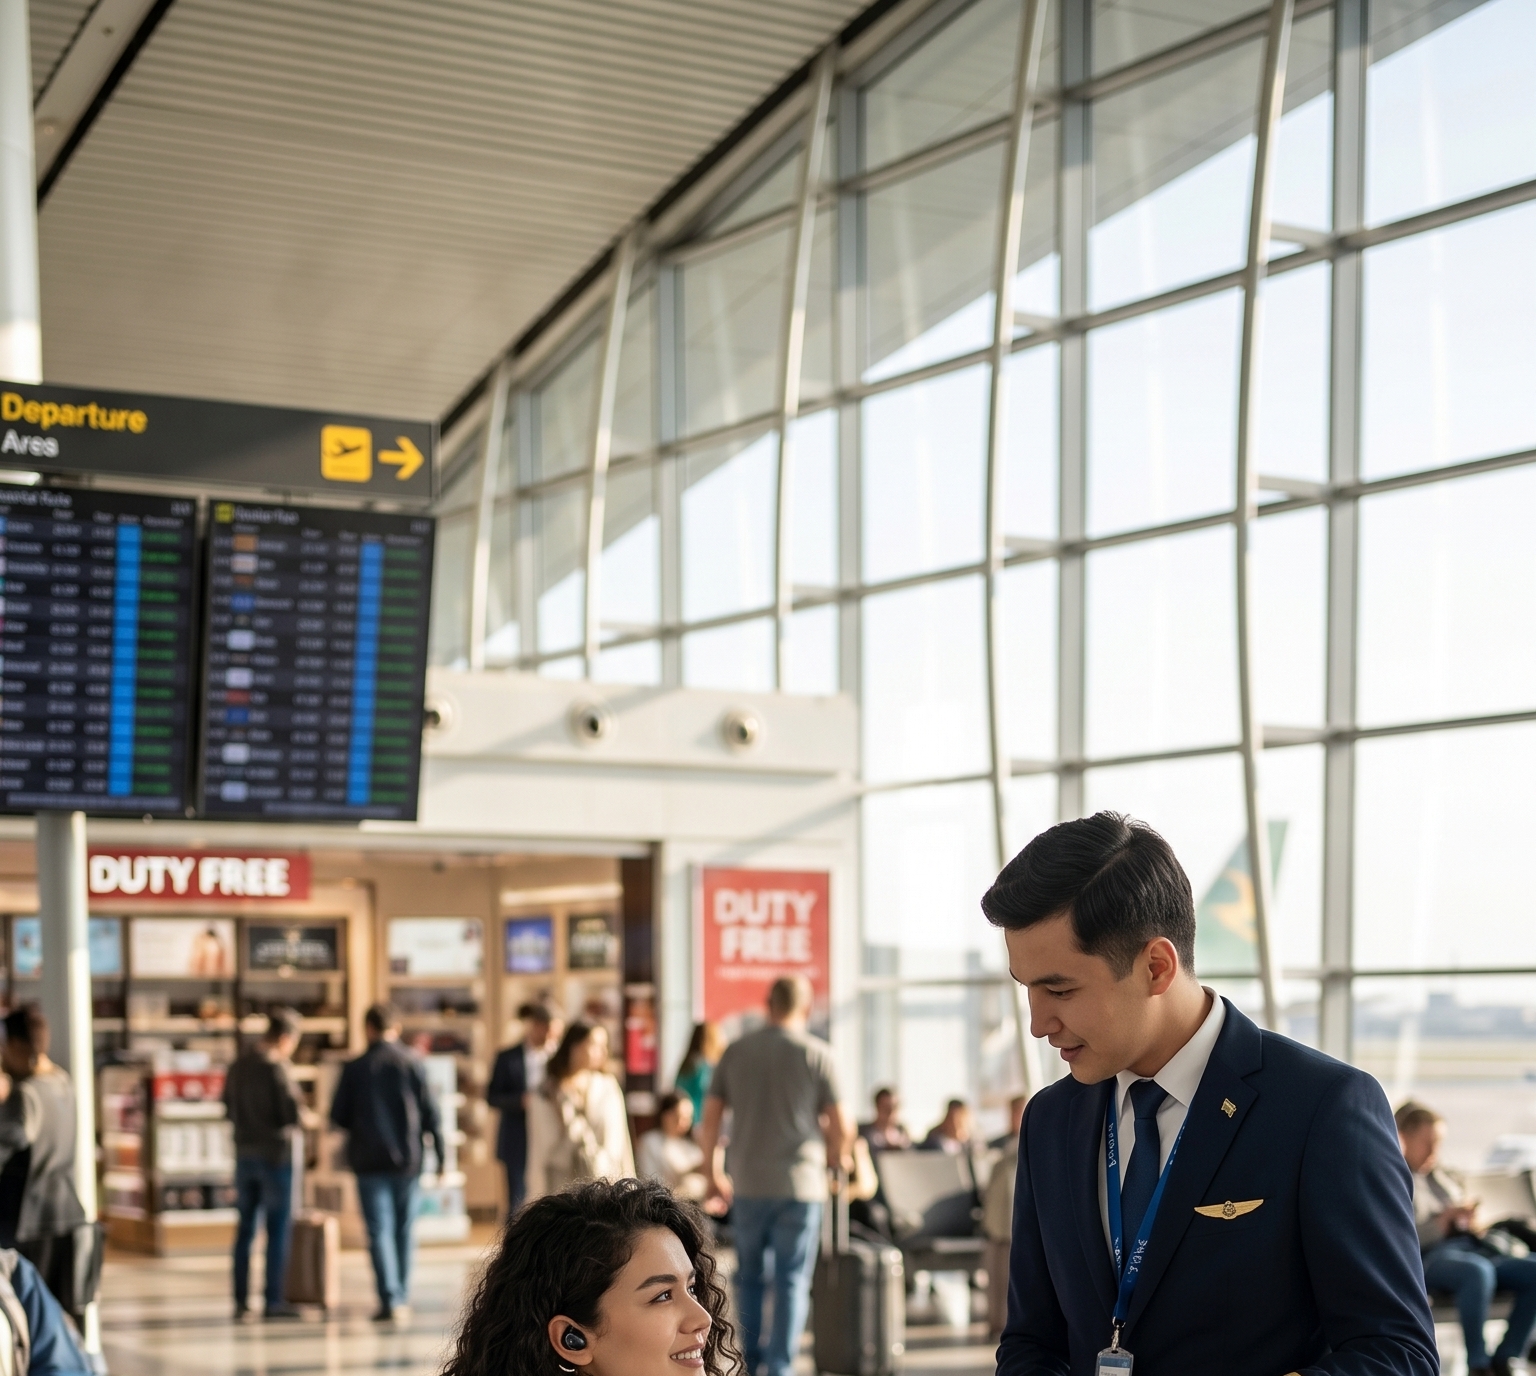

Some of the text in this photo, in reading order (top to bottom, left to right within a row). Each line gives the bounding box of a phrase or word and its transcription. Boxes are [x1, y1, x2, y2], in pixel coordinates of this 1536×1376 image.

[1, 392, 148, 434] Departure
[90, 855, 290, 896] DUTY FREE
[714, 888, 817, 925] DUTY
[720, 925, 812, 963] FREE
